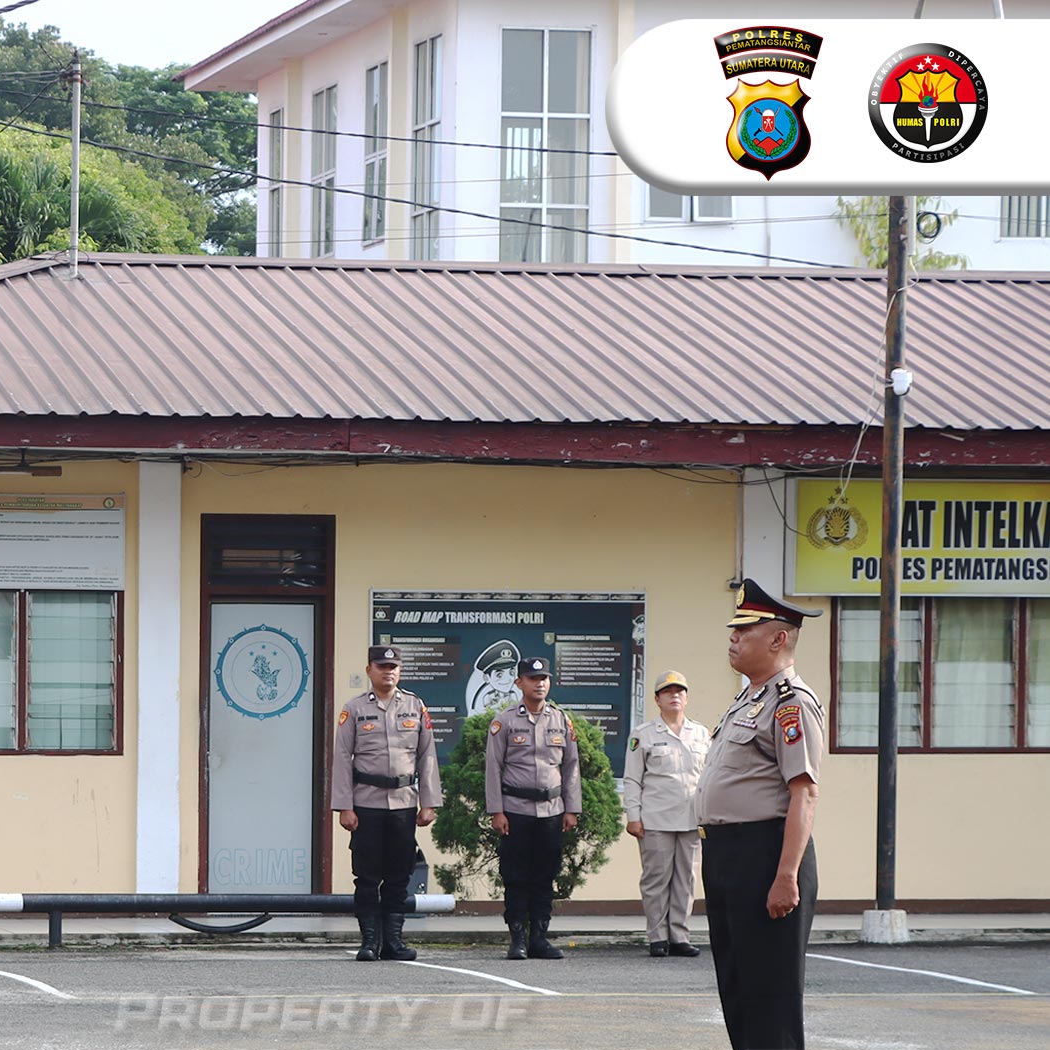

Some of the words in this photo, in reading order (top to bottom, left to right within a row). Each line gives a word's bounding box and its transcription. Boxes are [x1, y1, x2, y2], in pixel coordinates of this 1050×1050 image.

[901, 501, 936, 548] AT
[852, 557, 925, 580] POES
[393, 611, 421, 623] ROAD
[421, 611, 444, 623] MAP
[445, 611, 516, 624] TRANSFORMASI
[517, 612, 544, 624] POLRI
[213, 848, 306, 887] CRIME
